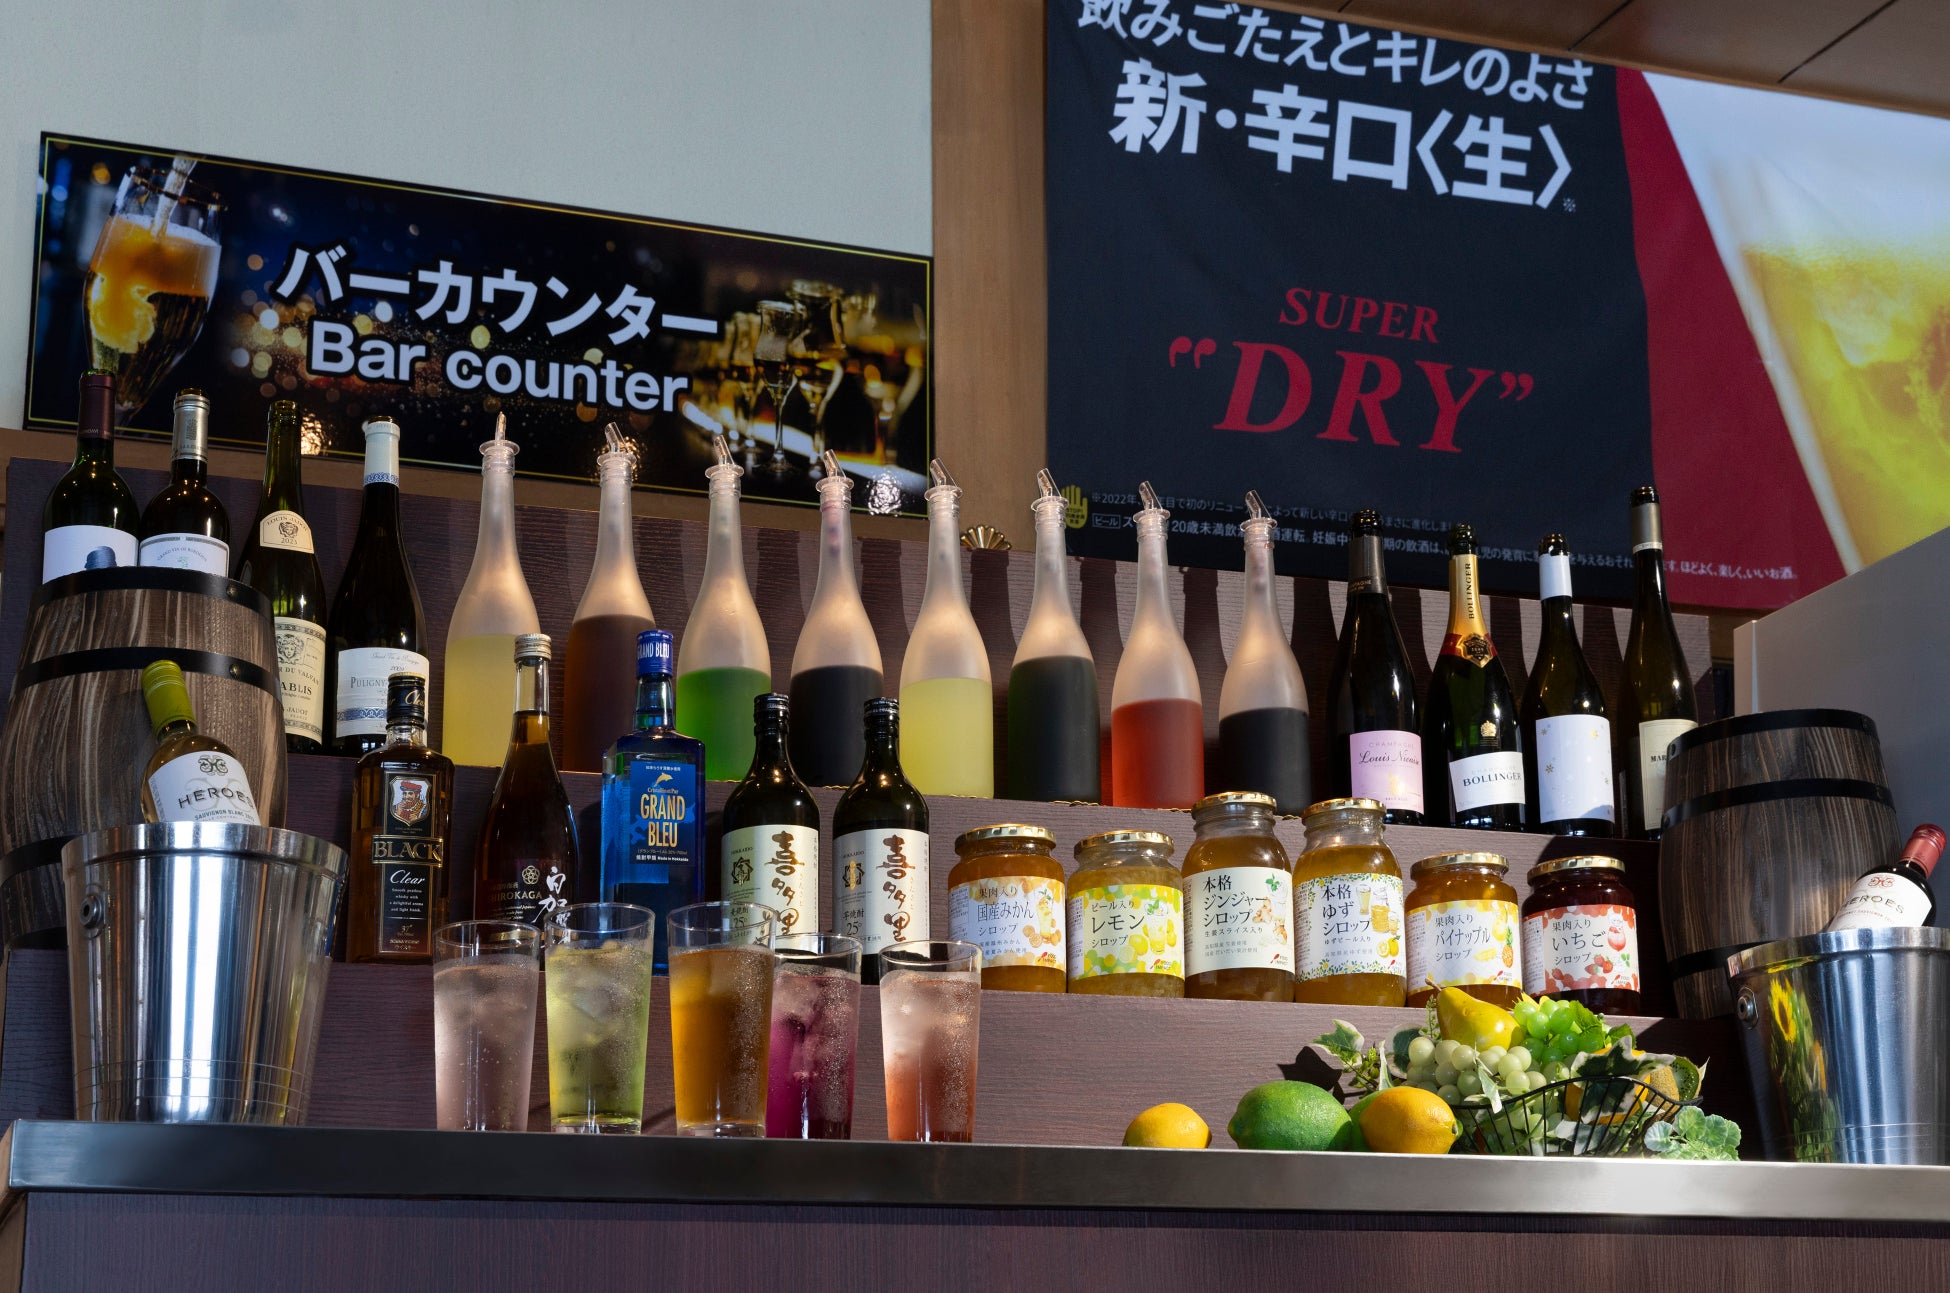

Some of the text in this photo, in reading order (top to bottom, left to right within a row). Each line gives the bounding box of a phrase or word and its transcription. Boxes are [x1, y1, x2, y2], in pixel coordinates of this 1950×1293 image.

[1077, 0, 1593, 109] 飲みごたえとキレのよさ
[275, 244, 719, 346] バーカウンター
[1279, 287, 1441, 344] SUPER
[311, 320, 688, 412] Bar counter
[1094, 515, 1120, 528] ビール
[1465, 563, 1475, 619] BOLLINGER
[637, 642, 670, 659] RAND BLEU
[280, 681, 312, 696] ABLIS
[1358, 750, 1390, 765] Louis
[1463, 772, 1522, 787] BOLLINGER
[178, 787, 254, 810] HEROES
[640, 793, 686, 821] GRAND
[194, 809, 227, 821] SAUVIGNON
[648, 821, 678, 848] BLEU
[373, 841, 441, 861] BLACK
[390, 869, 426, 884] Clear
[1203, 874, 1232, 893] 本格
[979, 886, 1019, 899] 果肉入り
[1203, 891, 1268, 911] ジンジャー
[1321, 884, 1351, 902] 本格
[977, 901, 1034, 922] 国産みかん
[1203, 908, 1254, 928] シロップ
[1322, 901, 1355, 920] ゆず
[978, 922, 1019, 937] シロップ
[1092, 914, 1145, 934] レモン
[1435, 914, 1473, 928] 果肉入り
[1552, 919, 1591, 932] 果肉入り
[1091, 934, 1129, 949] シロップ
[1435, 926, 1491, 947] パイナップル
[1552, 930, 1606, 951] いちご
[1435, 948, 1472, 962] シロップ
[1554, 952, 1592, 965] シロップ
